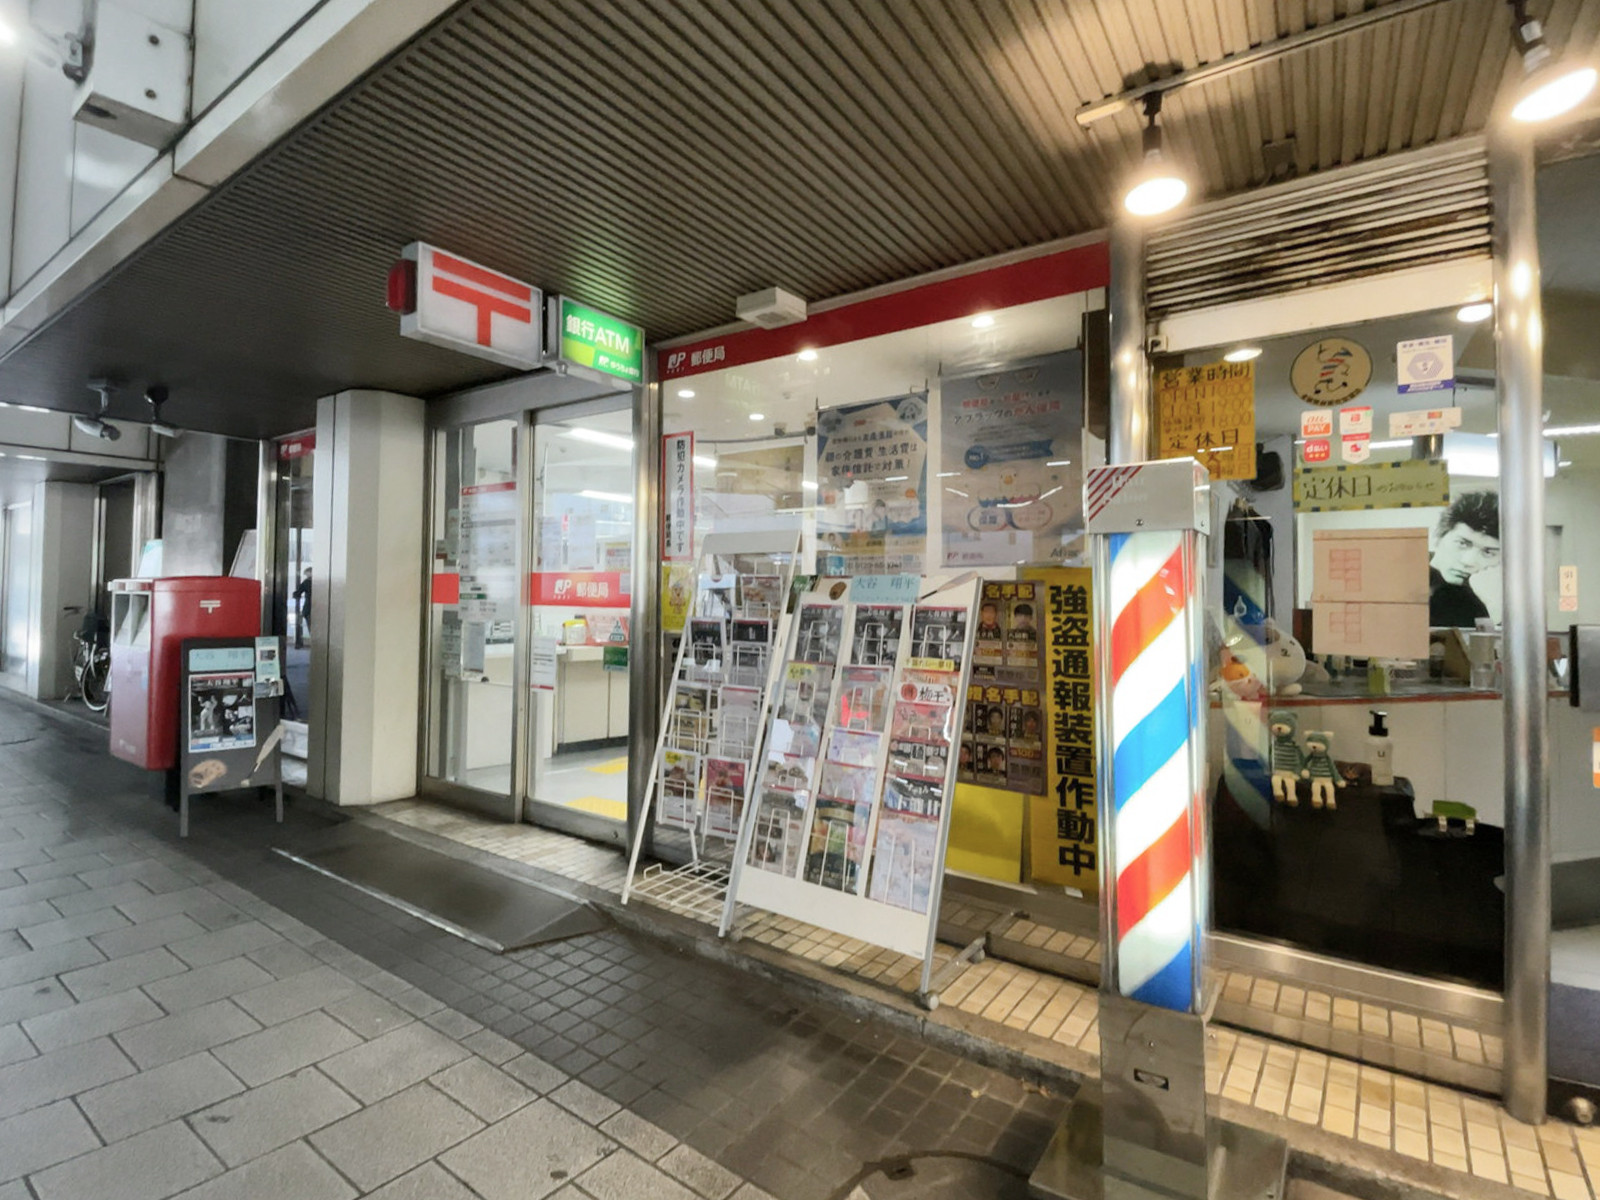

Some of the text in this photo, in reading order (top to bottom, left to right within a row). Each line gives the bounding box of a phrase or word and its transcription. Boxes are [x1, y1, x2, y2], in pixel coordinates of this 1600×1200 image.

[566, 314, 630, 354] 銀行ATM
[691, 346, 726, 366] 郵便局
[1161, 362, 1250, 391] 営業時間
[1307, 423, 1326, 433] PAY
[1168, 428, 1239, 449] 定休日
[576, 582, 609, 598] 郵便局
[856, 577, 878, 589] 大谷
[981, 583, 1036, 601] 名手配
[1049, 584, 1096, 876] 強盗通報装置作動中
